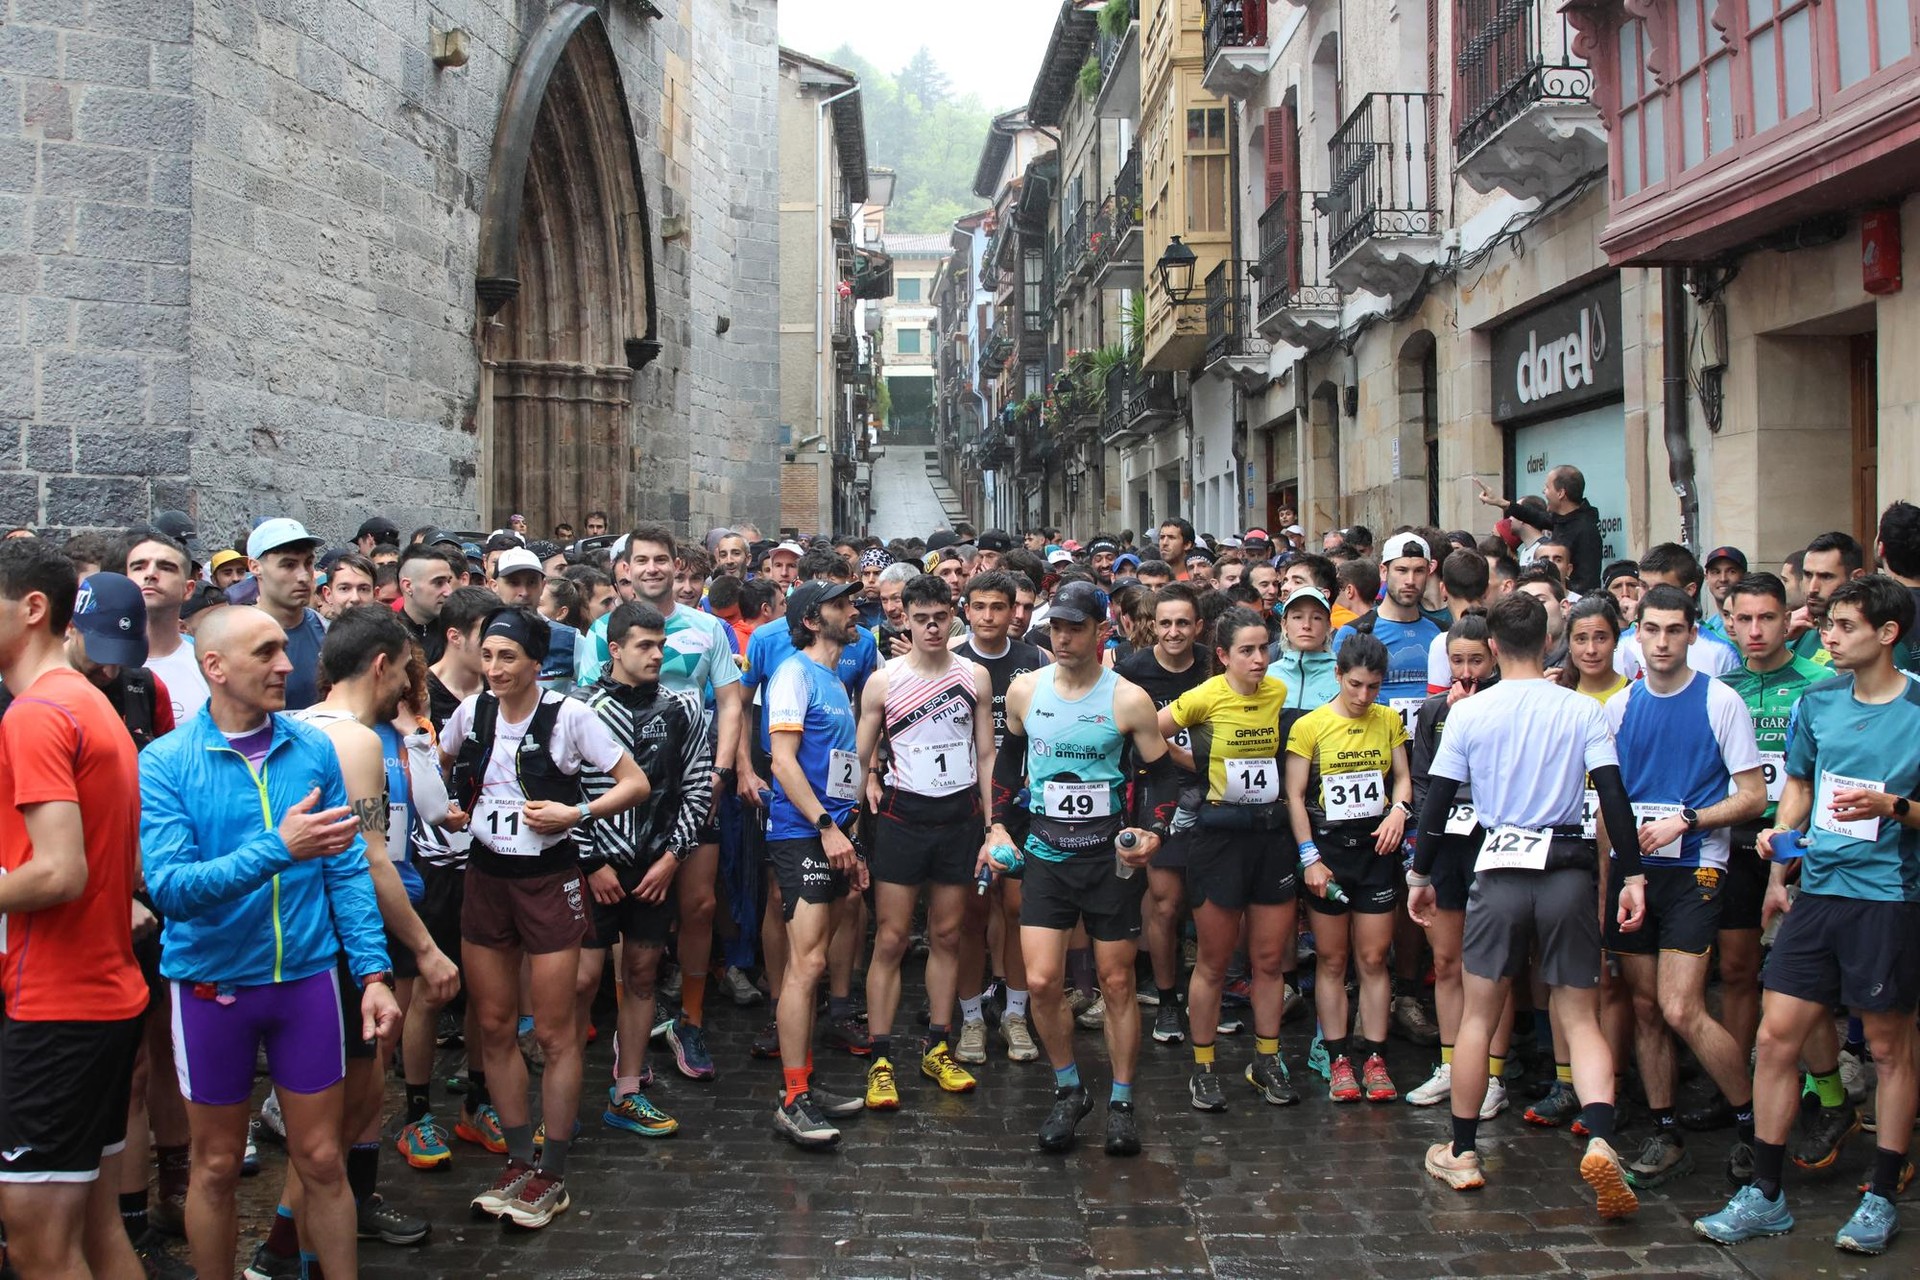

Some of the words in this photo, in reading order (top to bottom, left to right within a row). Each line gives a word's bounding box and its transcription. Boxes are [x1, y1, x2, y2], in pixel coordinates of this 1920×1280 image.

[1517, 308, 1594, 404] clarel
[1527, 453, 1546, 474] clarel
[1597, 517, 1622, 539] agoen
[906, 709, 924, 723] LA
[923, 692, 950, 713] SPO
[1235, 727, 1275, 738] GAIKAR
[1055, 742, 1097, 753] SORONEA
[1337, 749, 1381, 760] GAIKAR
[843, 763, 853, 784] 2
[934, 753, 947, 773] 1
[1240, 769, 1268, 790] 14
[1330, 781, 1380, 806] 314
[1058, 794, 1095, 816] 49
[486, 810, 519, 836] 11
[1833, 826, 1853, 836] LANA
[1485, 832, 1543, 854] 427
